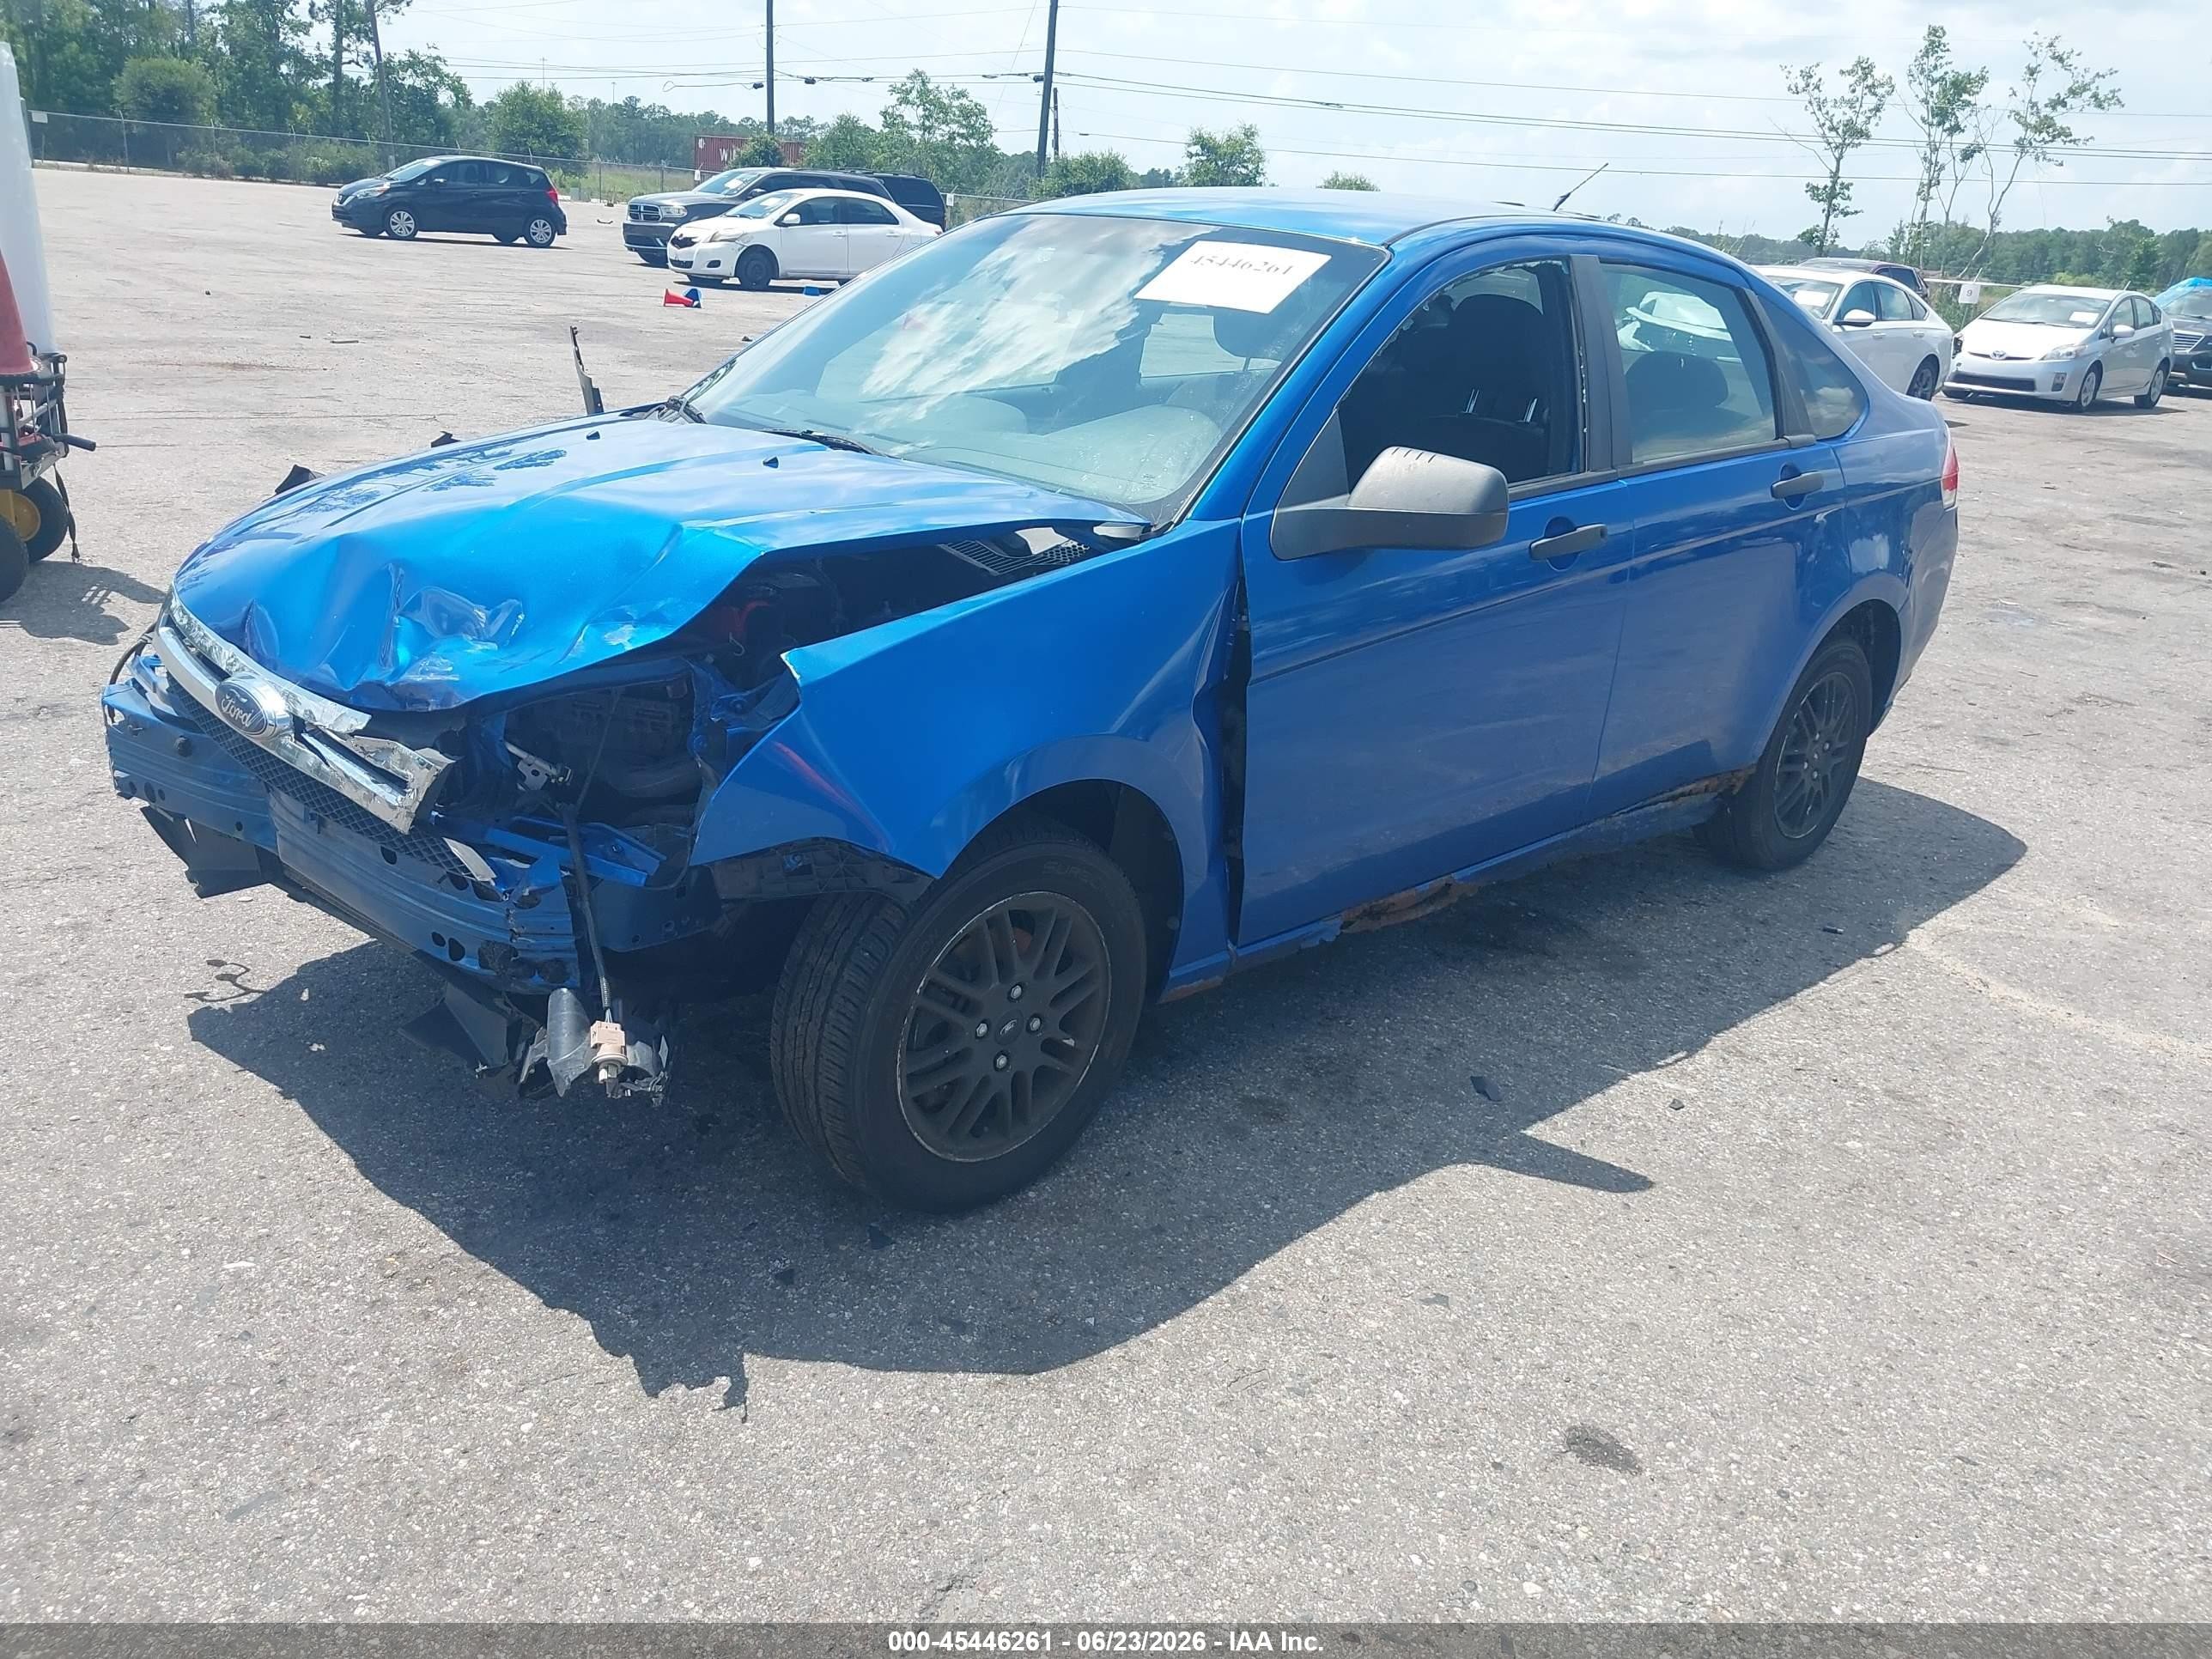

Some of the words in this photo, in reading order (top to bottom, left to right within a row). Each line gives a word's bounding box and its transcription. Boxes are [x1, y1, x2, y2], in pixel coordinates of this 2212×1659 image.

[1190, 255, 1294, 276] 45446261
[1966, 289, 1973, 298] 9
[221, 689, 254, 727] Ford
